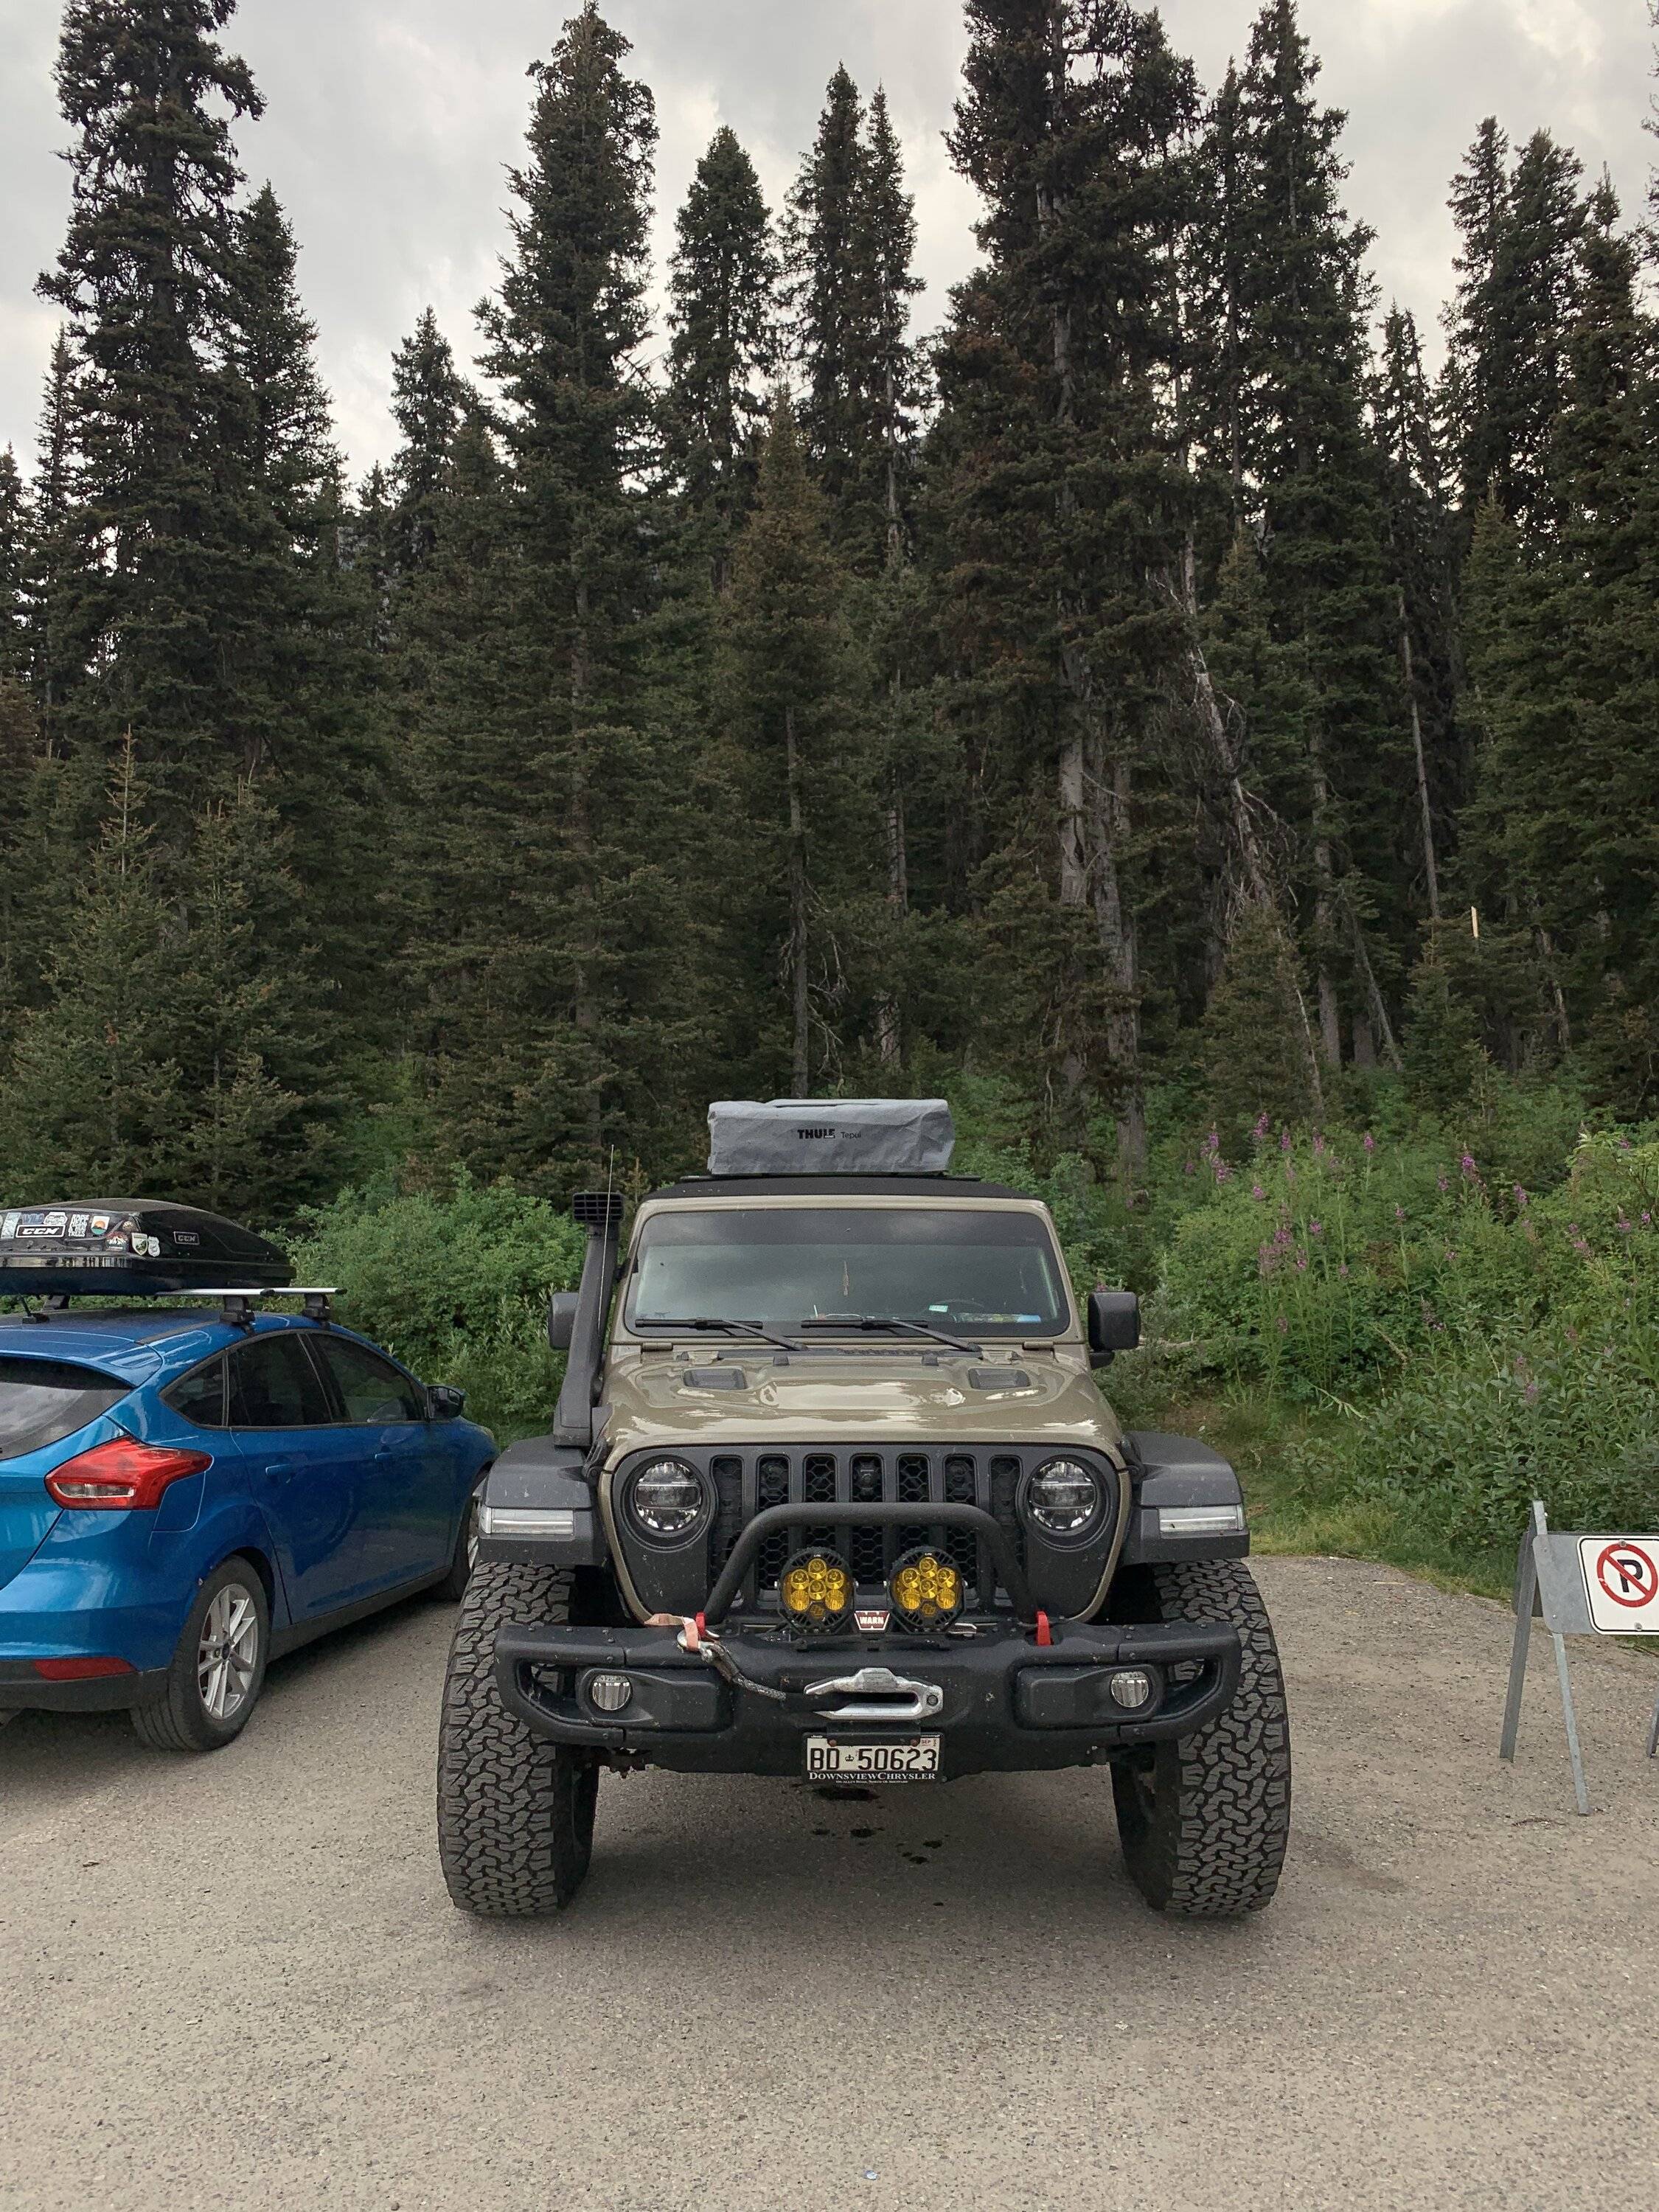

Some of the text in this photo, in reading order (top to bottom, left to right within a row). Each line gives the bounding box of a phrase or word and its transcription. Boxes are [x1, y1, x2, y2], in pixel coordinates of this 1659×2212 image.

[797, 1129, 835, 1139] THULE
[1617, 1559, 1643, 1593] P
[860, 1616, 884, 1624] WARN
[810, 1747, 936, 1770] BD 50623
